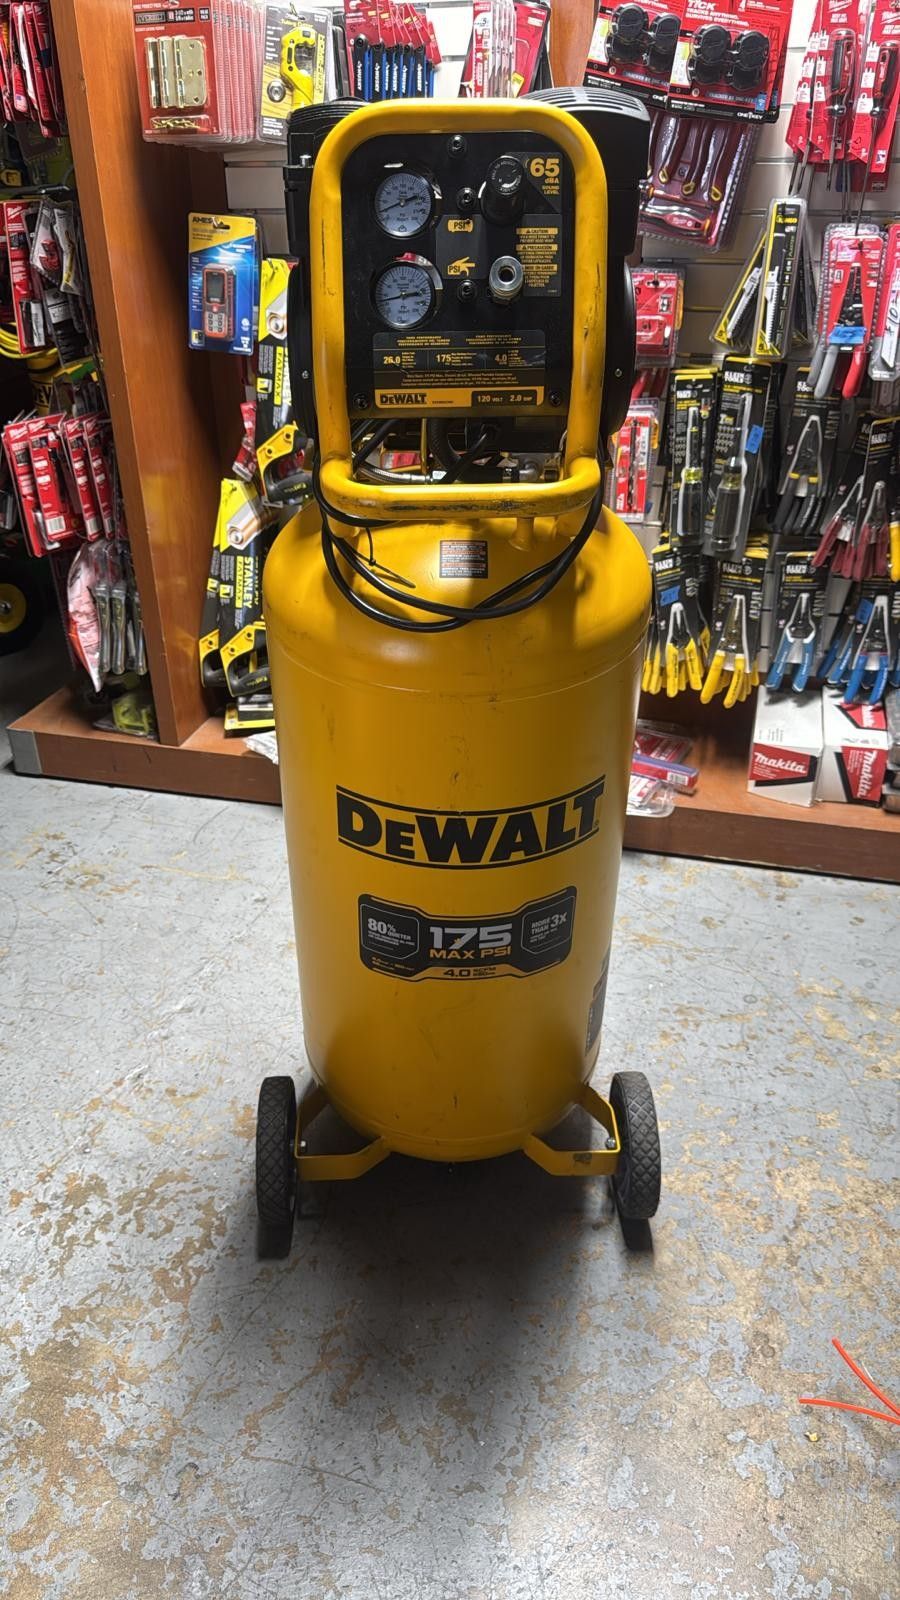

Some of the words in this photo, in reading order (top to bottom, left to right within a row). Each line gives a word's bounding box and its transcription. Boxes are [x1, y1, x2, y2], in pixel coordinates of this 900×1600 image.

[530, 158, 560, 177] 65
[453, 221, 466, 230] PSI
[448, 265, 461, 274] PSI
[436, 354, 452, 363] 175
[477, 395, 491, 403] 120
[243, 556, 255, 609] STANLEY
[336, 781, 605, 864] DEWALT
[429, 923, 513, 950] 175
[429, 948, 475, 959] MAX
[480, 946, 512, 959] PSI
[443, 968, 471, 978] 4.0
